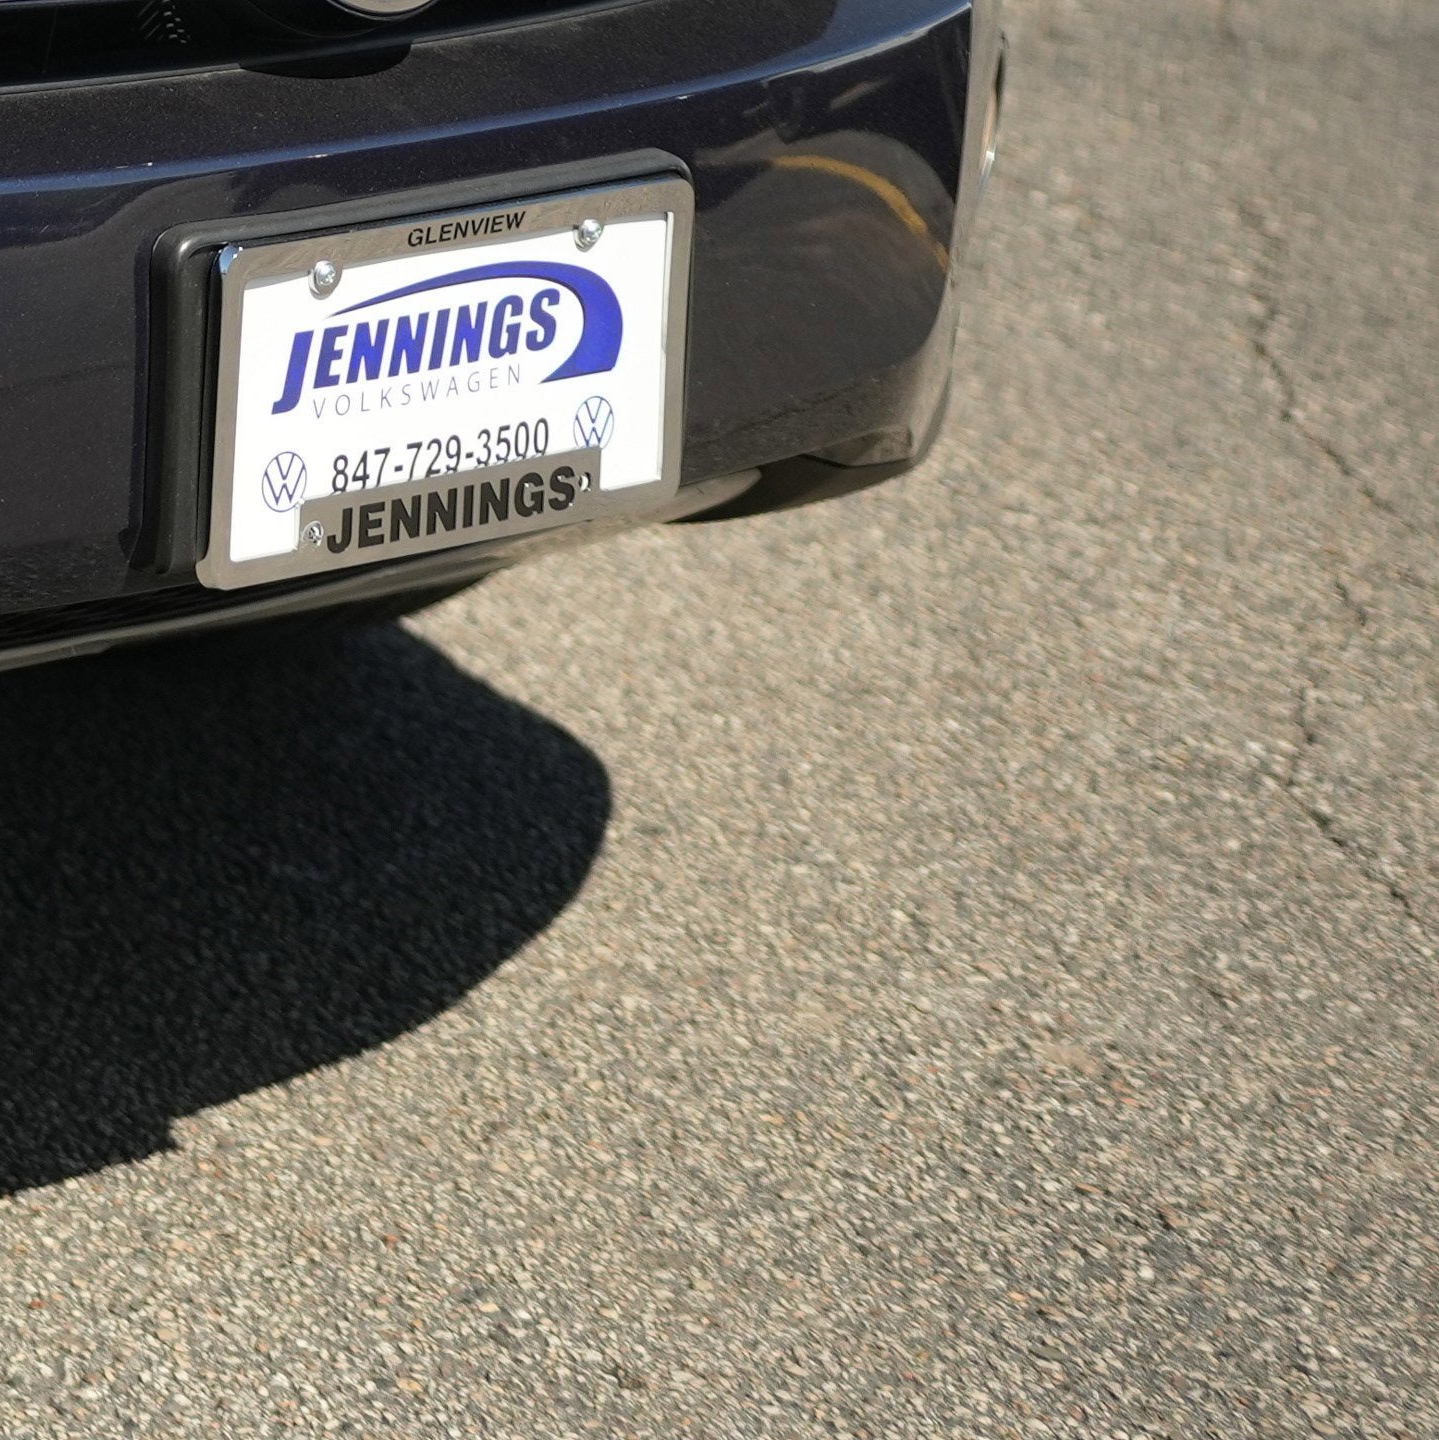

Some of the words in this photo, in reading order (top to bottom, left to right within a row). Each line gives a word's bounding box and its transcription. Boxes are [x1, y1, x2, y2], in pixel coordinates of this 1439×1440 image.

[407, 210, 526, 247] GLENVIEW
[270, 287, 561, 416] JENNINGS
[312, 363, 522, 420] VOLKSWAGEN
[331, 417, 550, 495] 847-729-3500
[326, 465, 577, 555] JENNINGS
